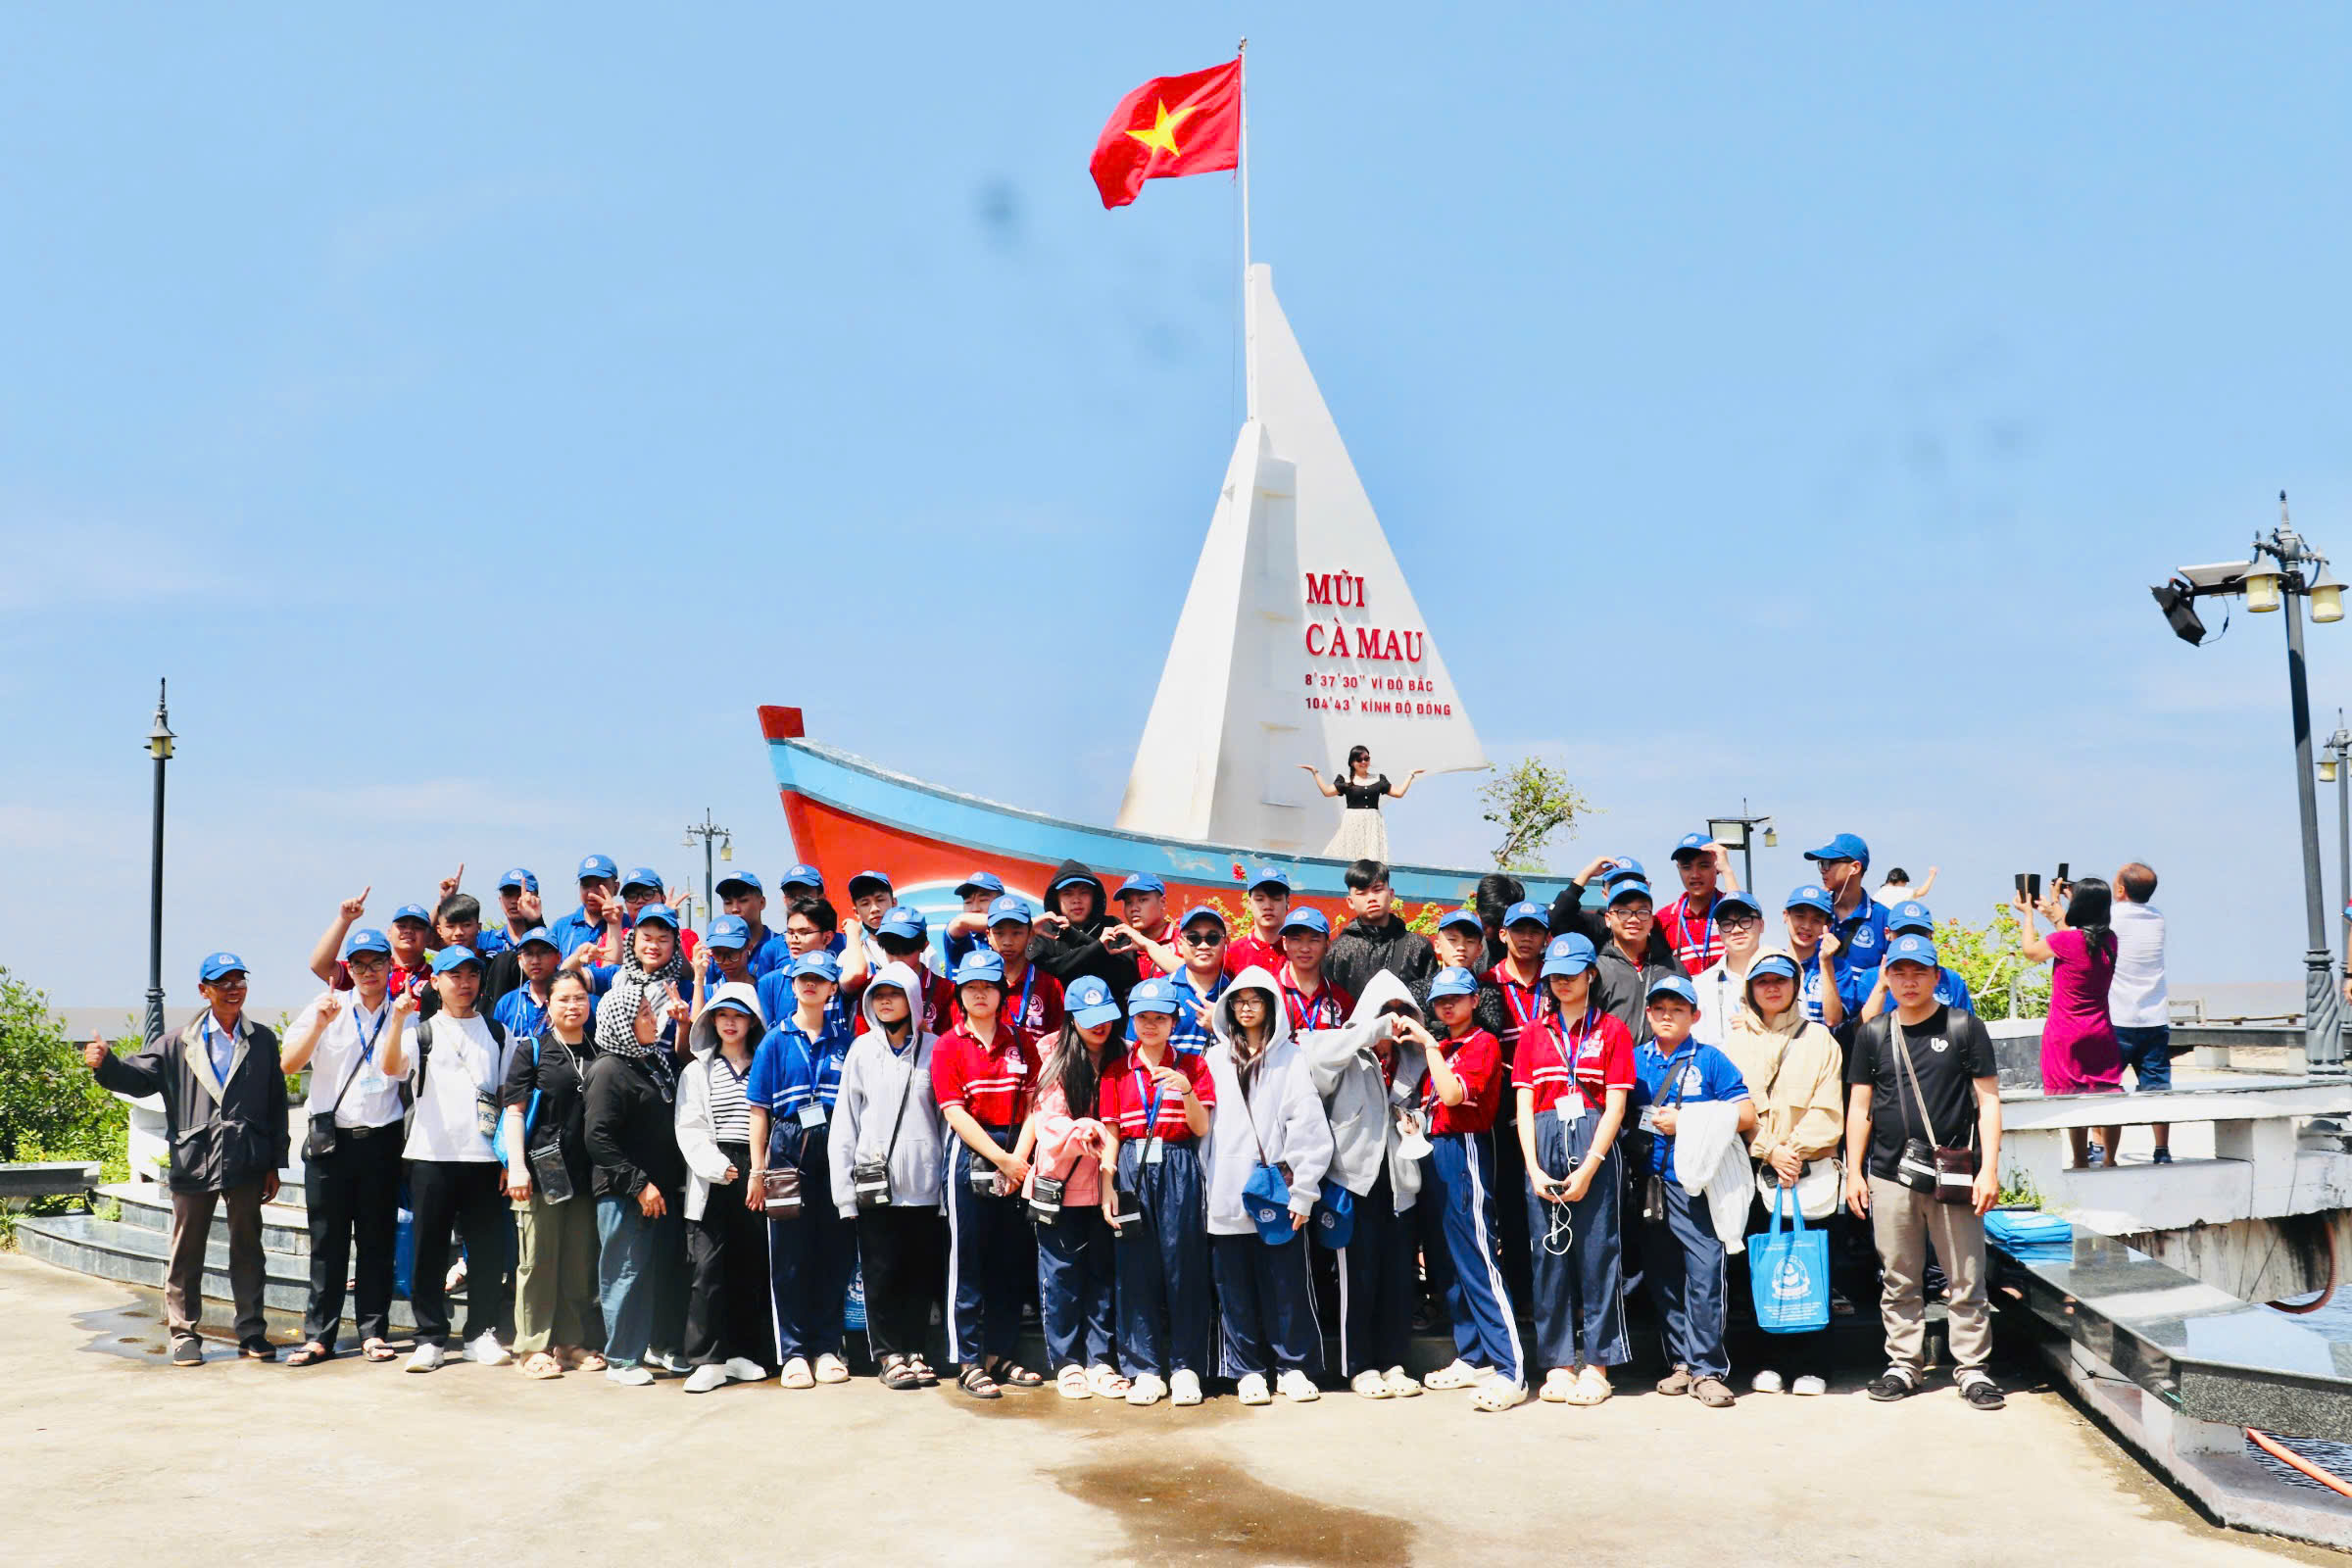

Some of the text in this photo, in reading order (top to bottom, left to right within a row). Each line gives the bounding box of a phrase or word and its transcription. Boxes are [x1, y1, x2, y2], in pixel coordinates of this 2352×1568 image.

[1306, 569, 1365, 608] MŨI
[1305, 616, 1423, 662] CÀ MAU
[1387, 675, 1403, 694] ĐỘ
[1395, 699, 1412, 717] ĐỘ
